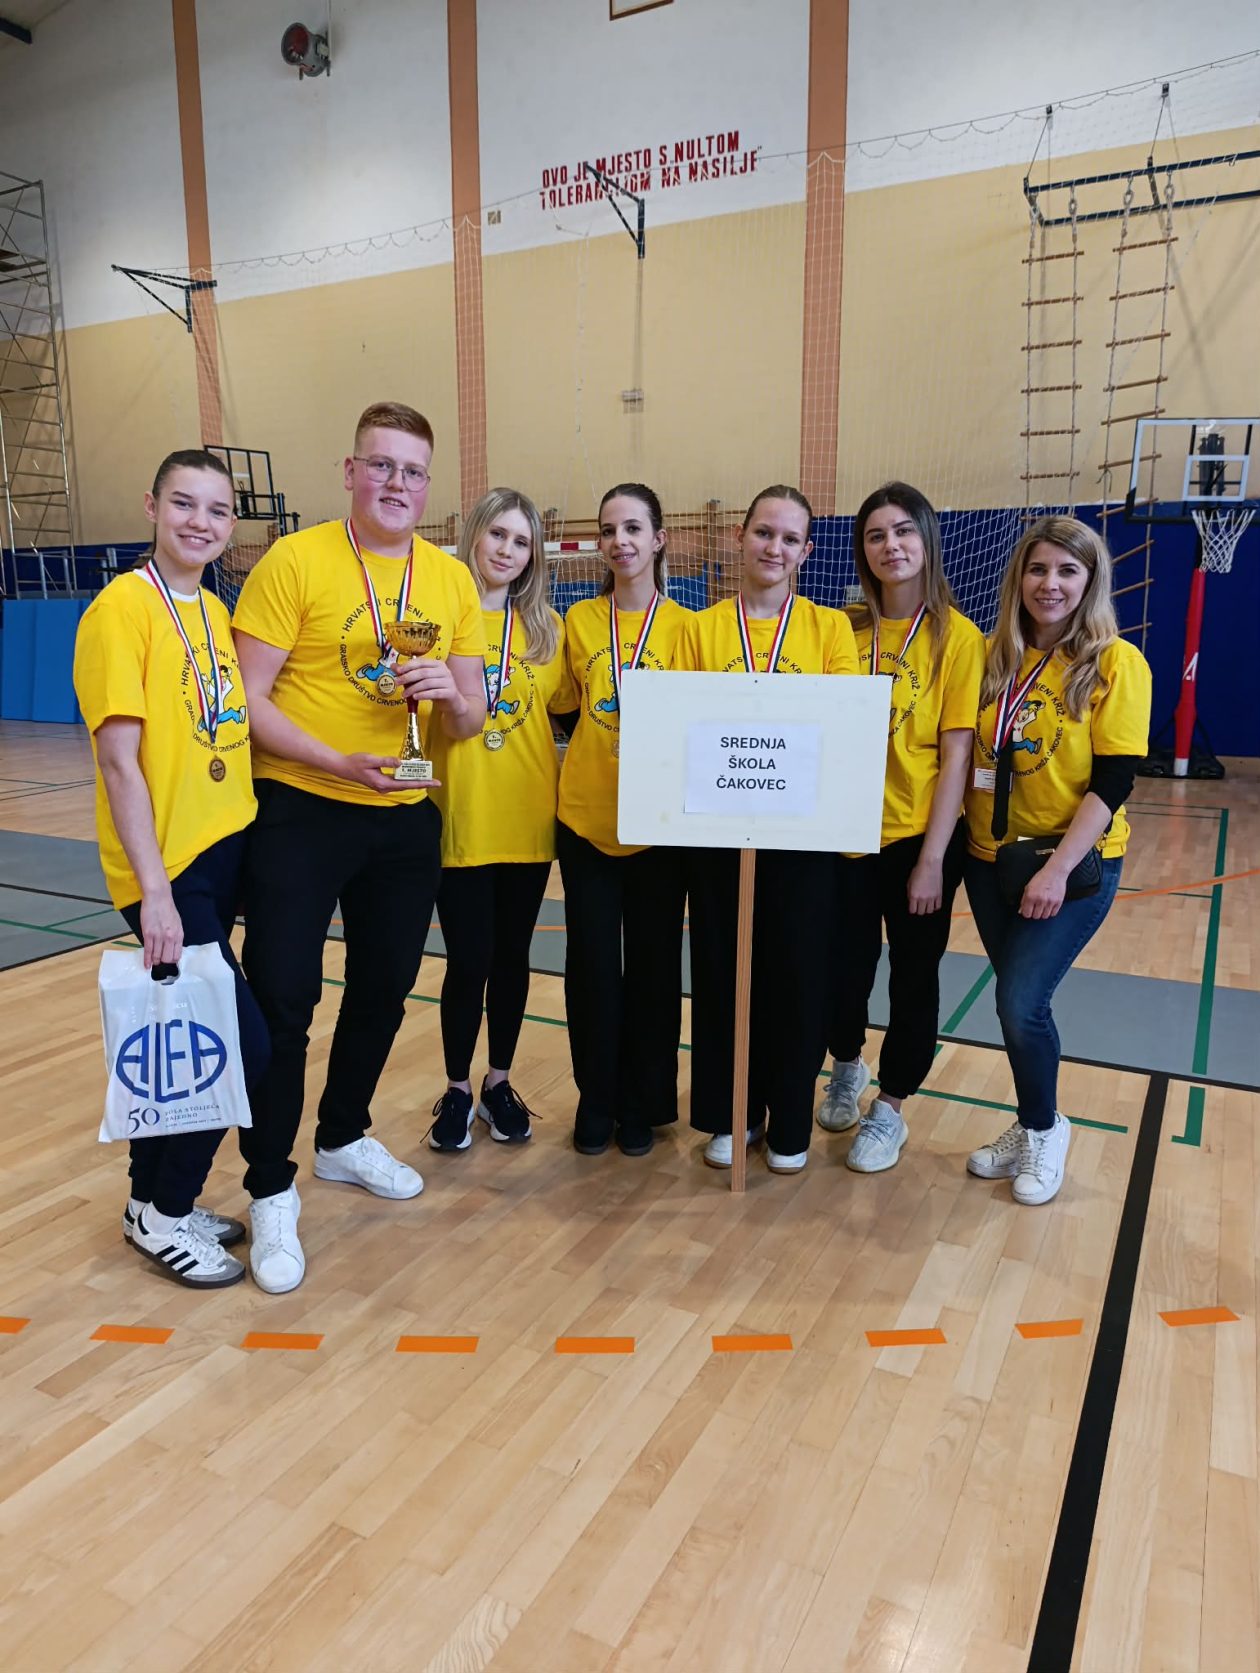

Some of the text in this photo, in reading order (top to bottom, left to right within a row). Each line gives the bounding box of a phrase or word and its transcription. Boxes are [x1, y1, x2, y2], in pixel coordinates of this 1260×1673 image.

[542, 166, 568, 188] OVO
[574, 161, 589, 181] JE
[596, 148, 651, 176] MJESTO
[659, 145, 667, 166] S
[539, 171, 651, 211] TOLERANIOM
[661, 165, 681, 188] NA
[342, 598, 423, 632] HRVATSI CRENI
[586, 646, 612, 671] HRVATS
[624, 642, 655, 658] CRENI
[756, 652, 790, 664] CRNI
[907, 670, 921, 690] KRIŽ
[376, 697, 408, 706] CRVENO
[1051, 697, 1066, 717] KRIŽ
[720, 736, 787, 750] SREDNJA
[728, 755, 777, 770] ŠKOLA
[716, 775, 787, 790] ČAKOVEC
[116, 1019, 228, 1104] ALFA
[128, 1107, 160, 1134] 50
